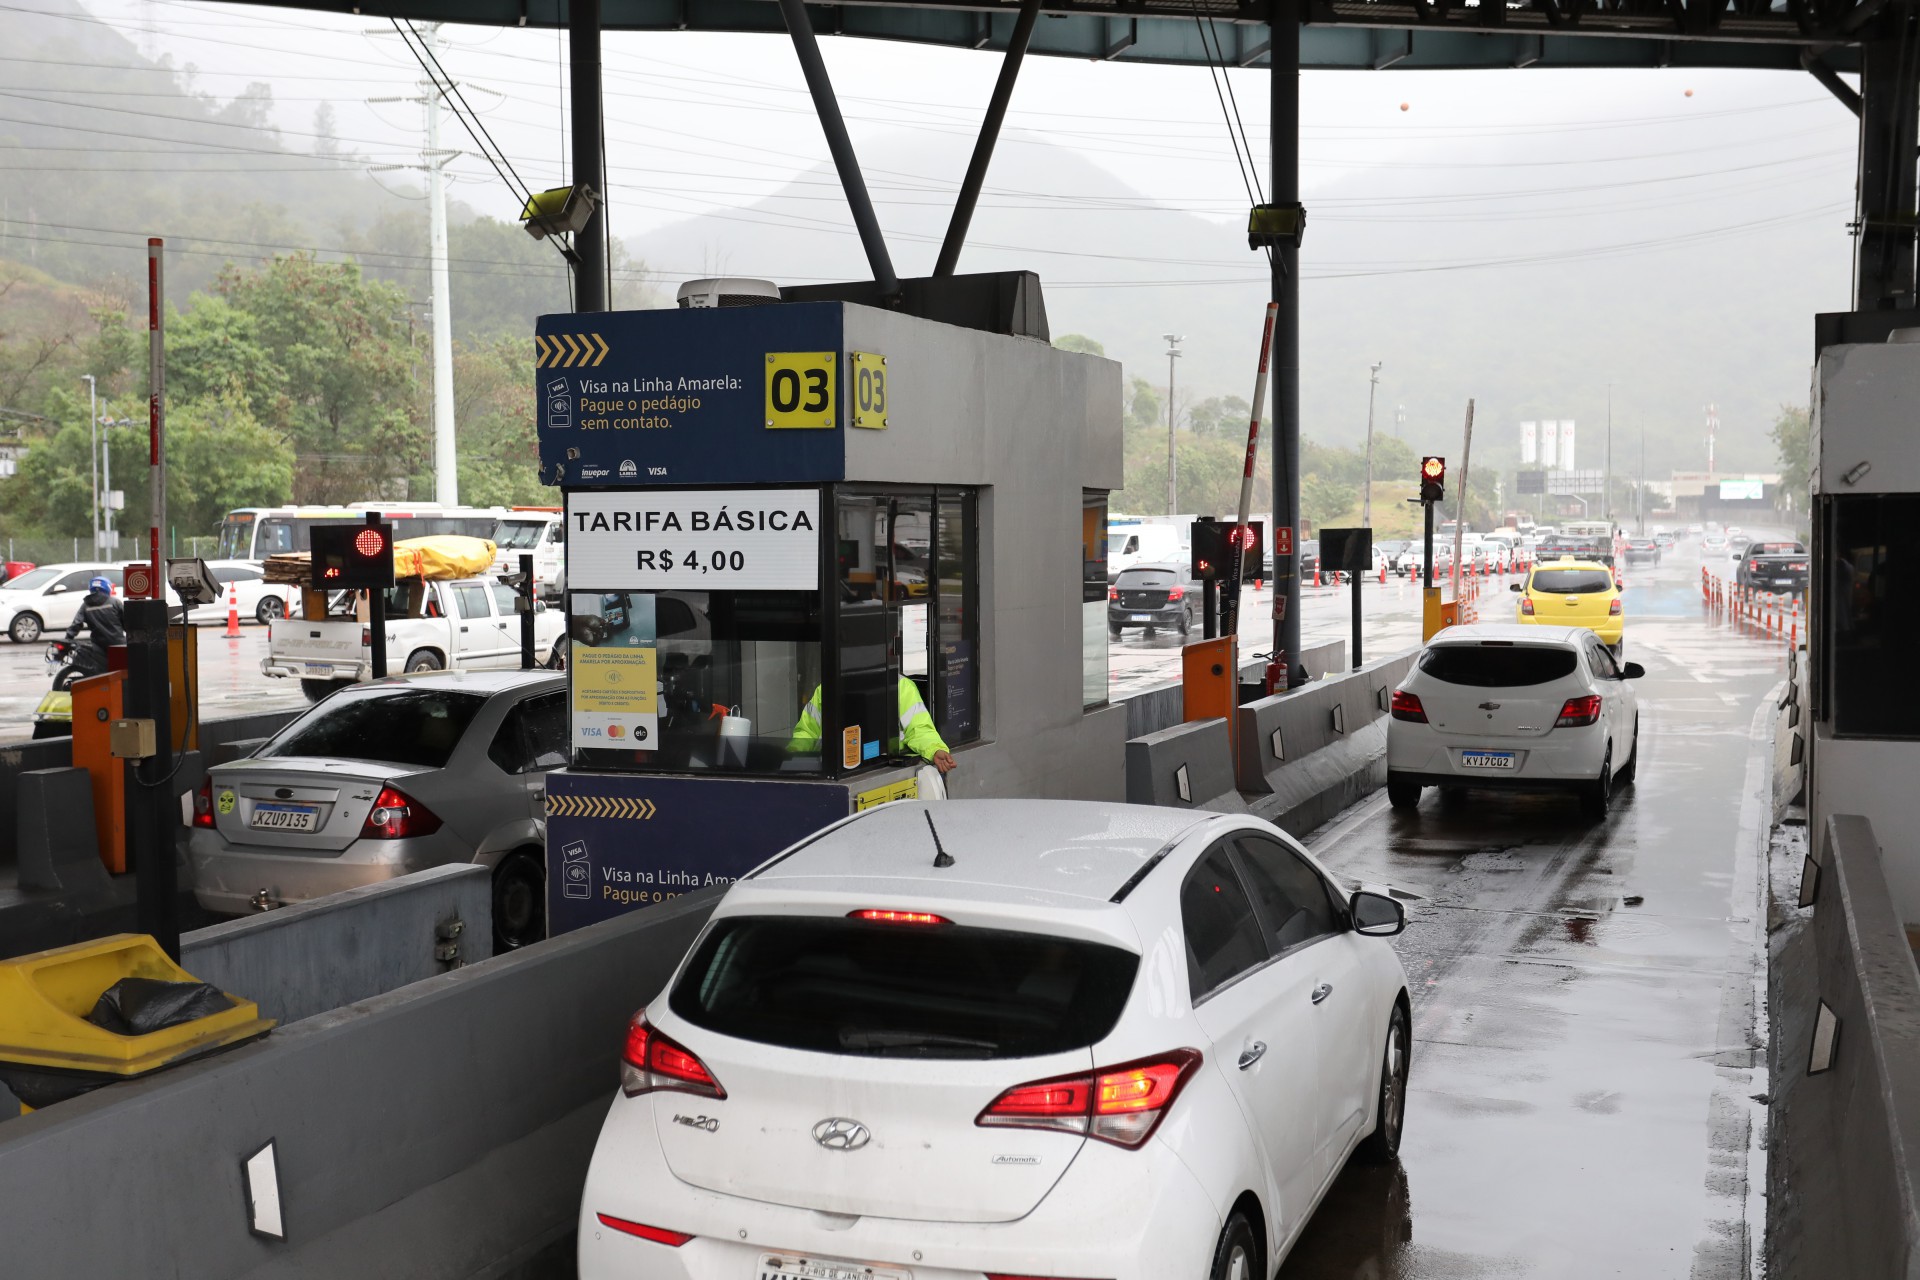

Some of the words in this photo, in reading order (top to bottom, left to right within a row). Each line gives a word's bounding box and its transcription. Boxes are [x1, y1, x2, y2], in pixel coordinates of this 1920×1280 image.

[580, 379, 608, 394] Visa
[612, 382, 629, 393] na
[634, 377, 673, 392] Linha
[677, 374, 742, 391] Amarela:
[771, 368, 829, 413] 03
[859, 368, 885, 413] 03
[581, 397, 624, 415] Pague
[628, 400, 638, 411] o
[641, 395, 701, 414] pedágio
[581, 420, 609, 430] sem
[613, 415, 673, 430] contato.
[581, 468, 610, 478] invepar
[647, 467, 667, 476] VISA
[573, 511, 683, 532] TARIFA
[691, 505, 814, 532] BÁSICA
[637, 549, 674, 573] R$
[683, 550, 745, 575] 4,00
[581, 728, 602, 737] VISA
[567, 847, 582, 856] VISA
[602, 866, 631, 883] Visa
[636, 872, 654, 884] na
[659, 869, 699, 887] Linha
[603, 885, 648, 905] Pague
[653, 892, 662, 902] o
